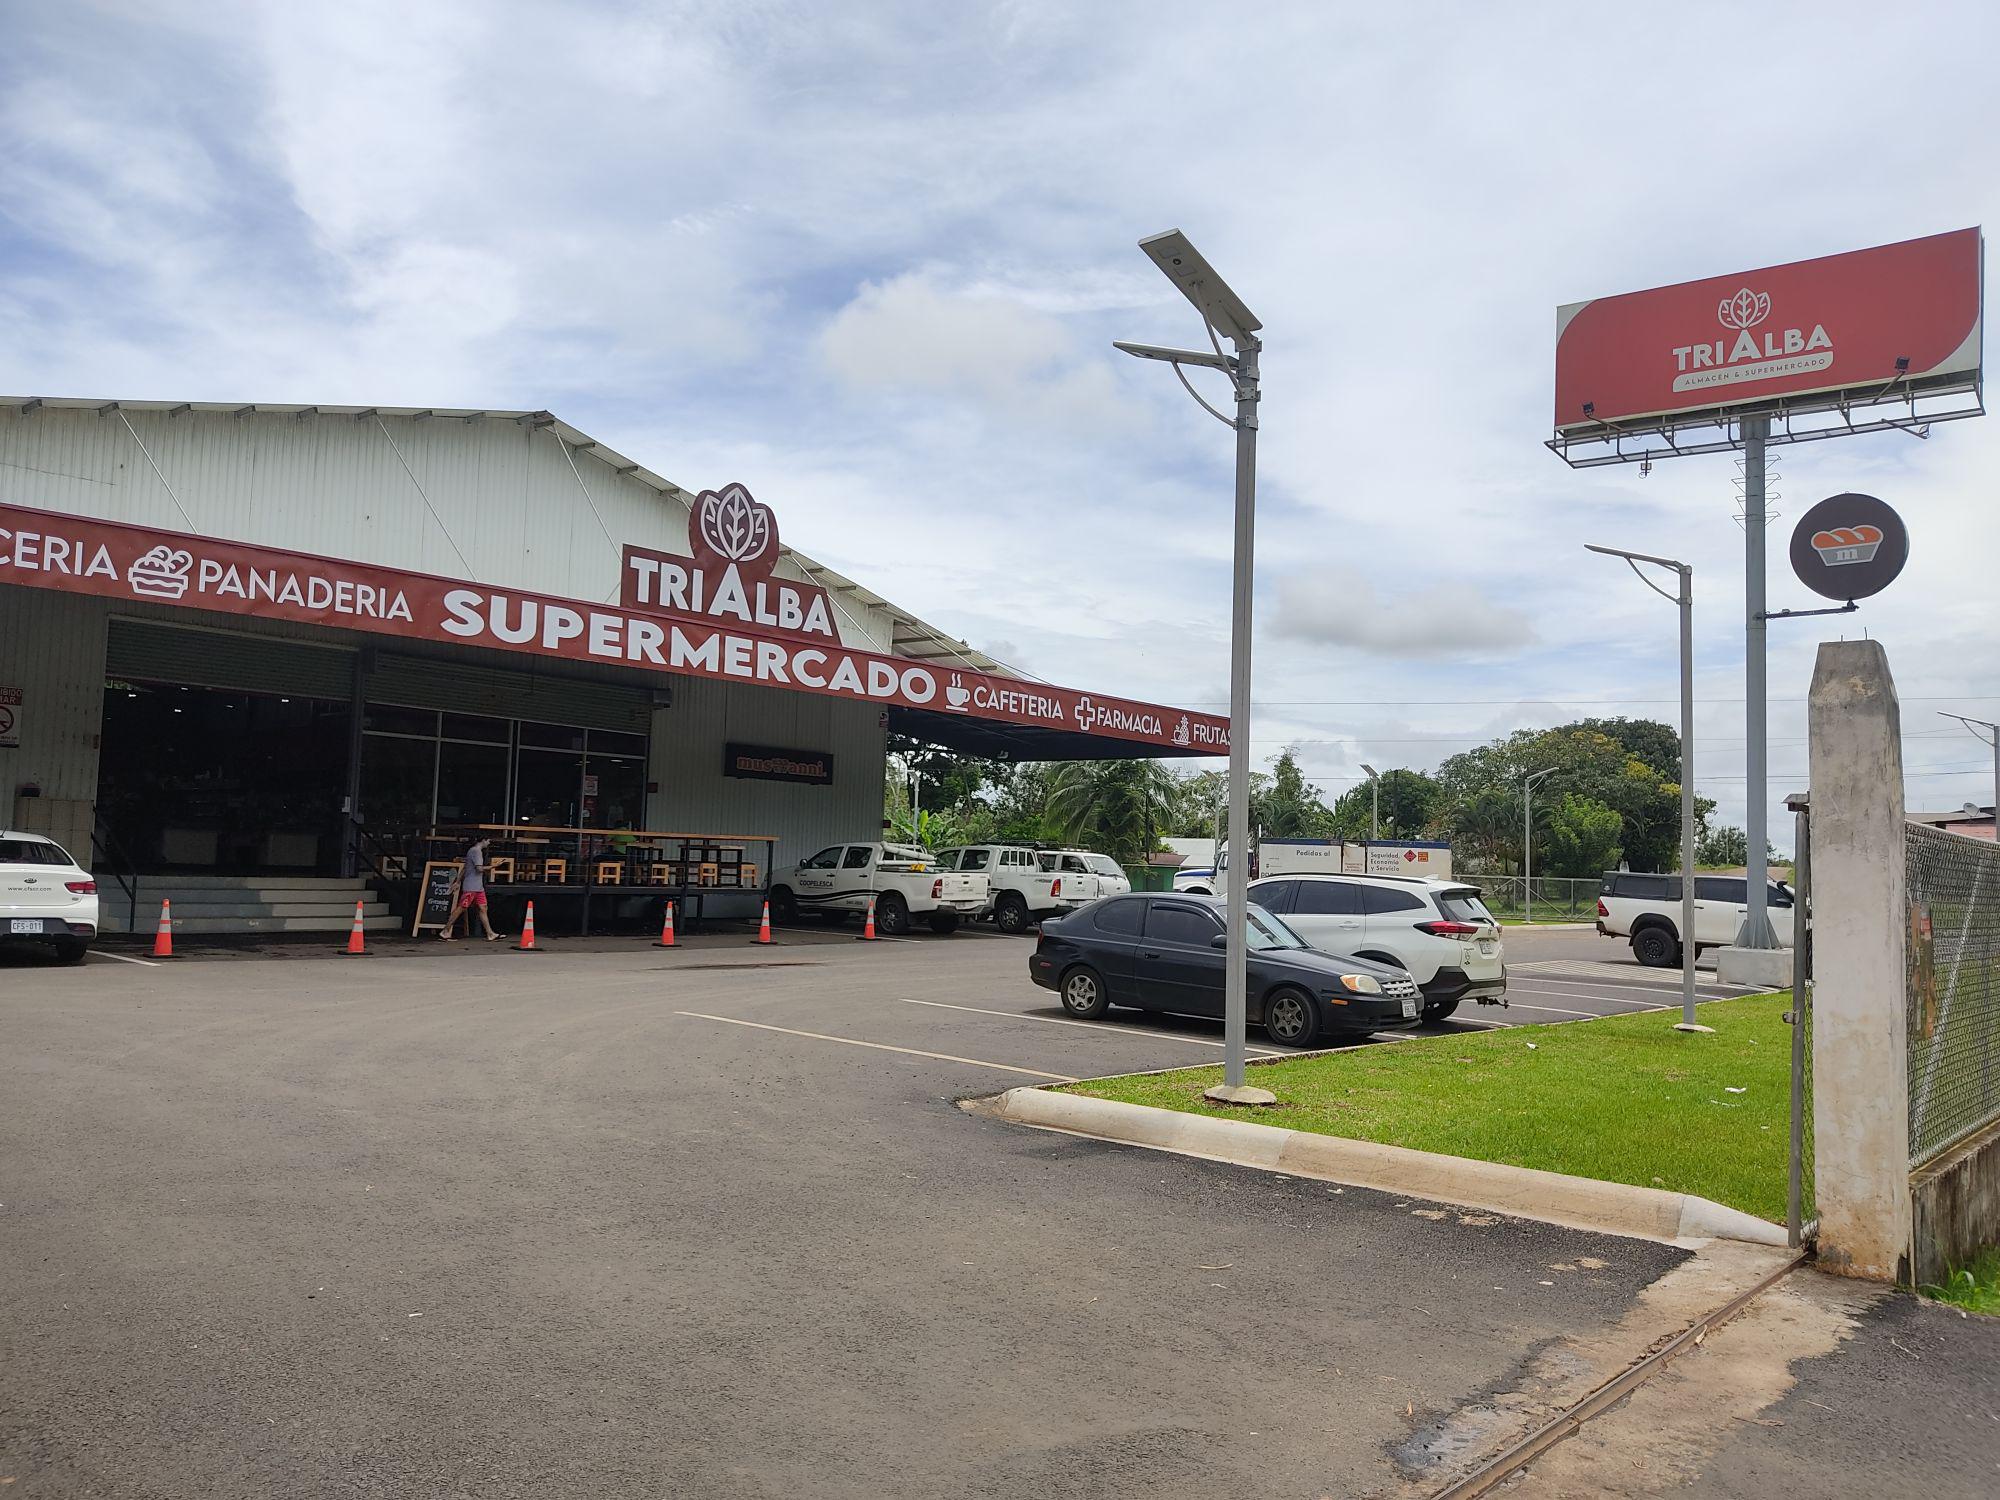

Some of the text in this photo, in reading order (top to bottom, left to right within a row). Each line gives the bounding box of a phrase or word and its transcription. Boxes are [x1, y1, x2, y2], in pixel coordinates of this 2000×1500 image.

[1672, 324, 1833, 371] TRIALBA
[1745, 358, 1825, 376] SUPERMERCADO
[629, 556, 833, 637] TRIALBA
[198, 559, 413, 622] PANADERIA
[440, 590, 937, 704] SUPERMERCADO
[973, 686, 1064, 720] CAFETERIA
[1096, 707, 1163, 736] FARMACIA
